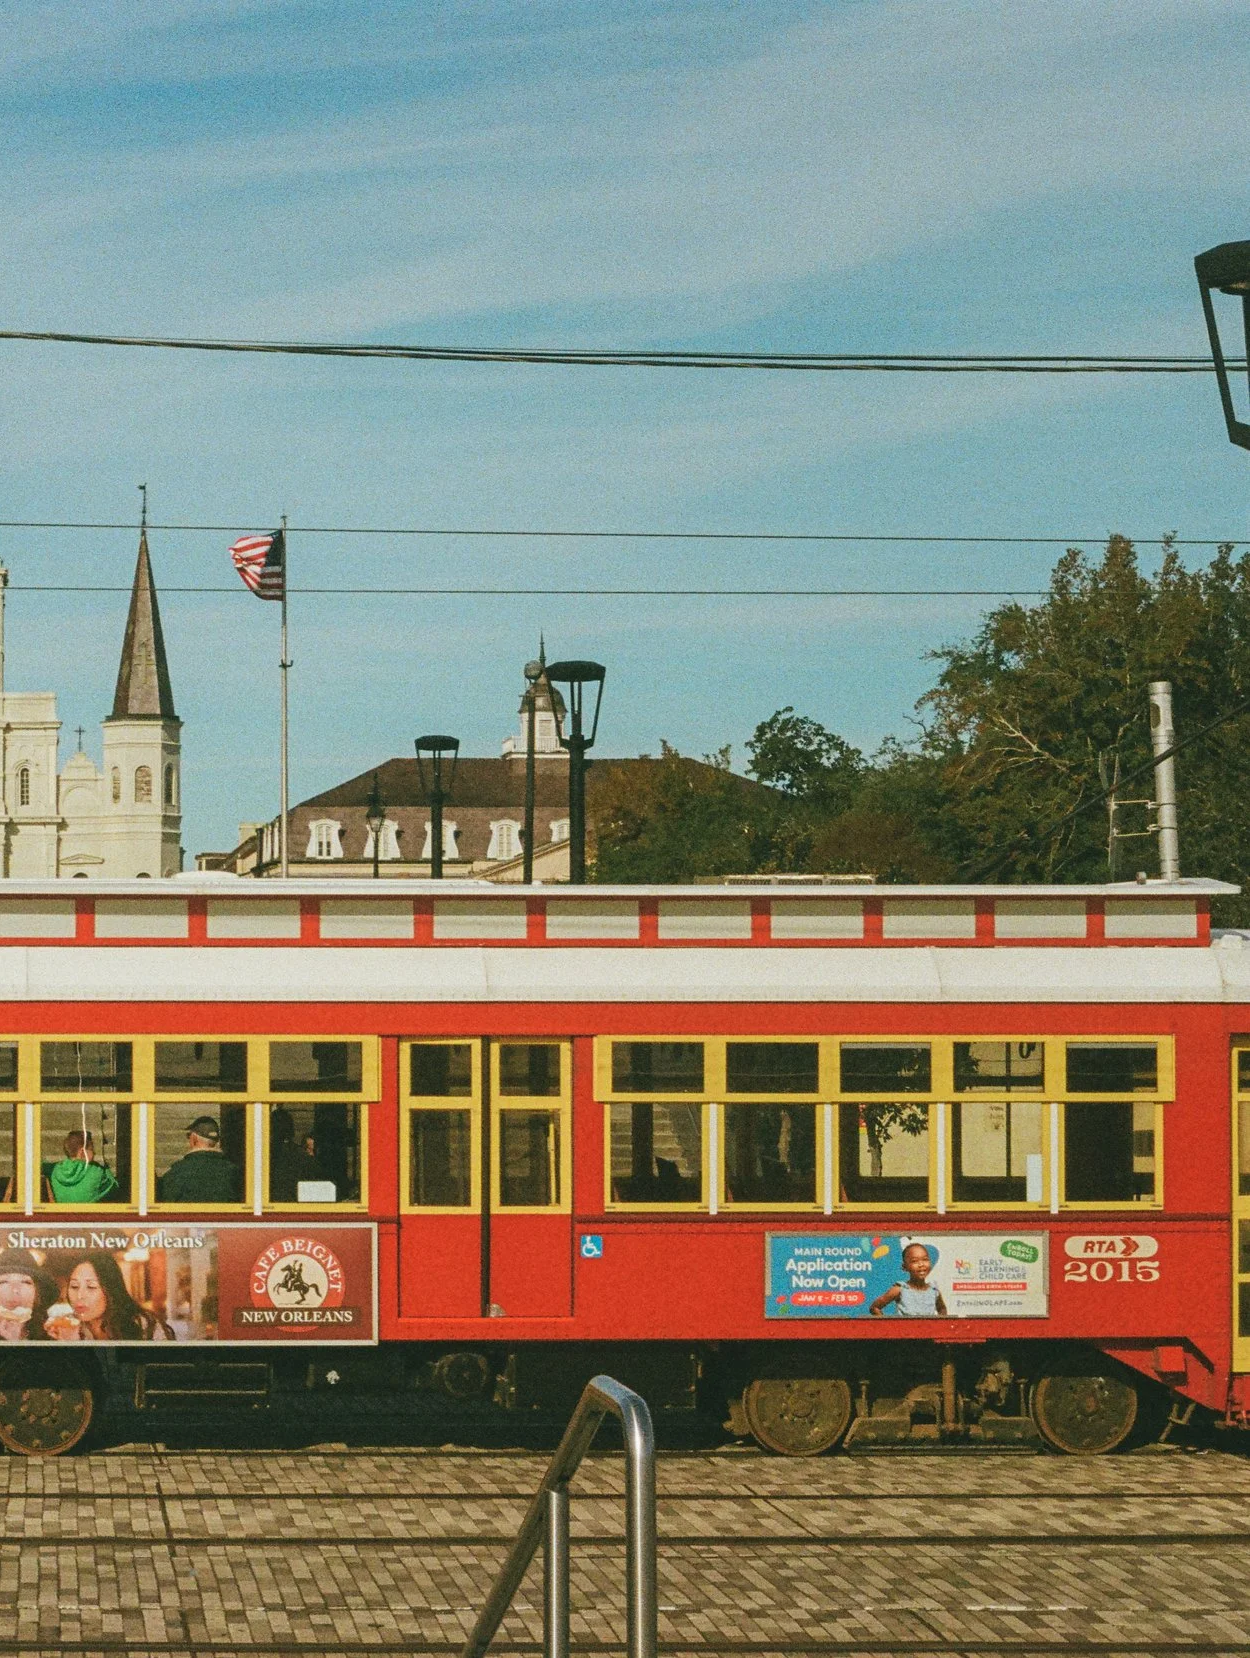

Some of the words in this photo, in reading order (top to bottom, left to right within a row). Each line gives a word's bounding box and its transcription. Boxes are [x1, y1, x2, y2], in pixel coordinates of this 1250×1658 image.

[7, 1231, 86, 1249] Sheraton
[90, 1232, 129, 1249] New
[133, 1230, 203, 1249] Orleans
[1083, 1240, 1116, 1253] RTA
[794, 1247, 822, 1256] MAIN
[824, 1247, 862, 1256] ROUND
[253, 1247, 280, 1294] CAFE
[281, 1239, 342, 1292] BEIGNET
[785, 1258, 872, 1275] Application
[1064, 1261, 1160, 1282] 2015
[792, 1275, 824, 1288] Now
[827, 1274, 866, 1291] Open
[979, 1272, 1004, 1280] CHILD
[1006, 1272, 1027, 1280] CARE
[798, 1294, 816, 1302] JAN
[831, 1294, 846, 1302] FEB
[241, 1310, 279, 1323] NEW
[281, 1310, 353, 1323] ORLEANS
